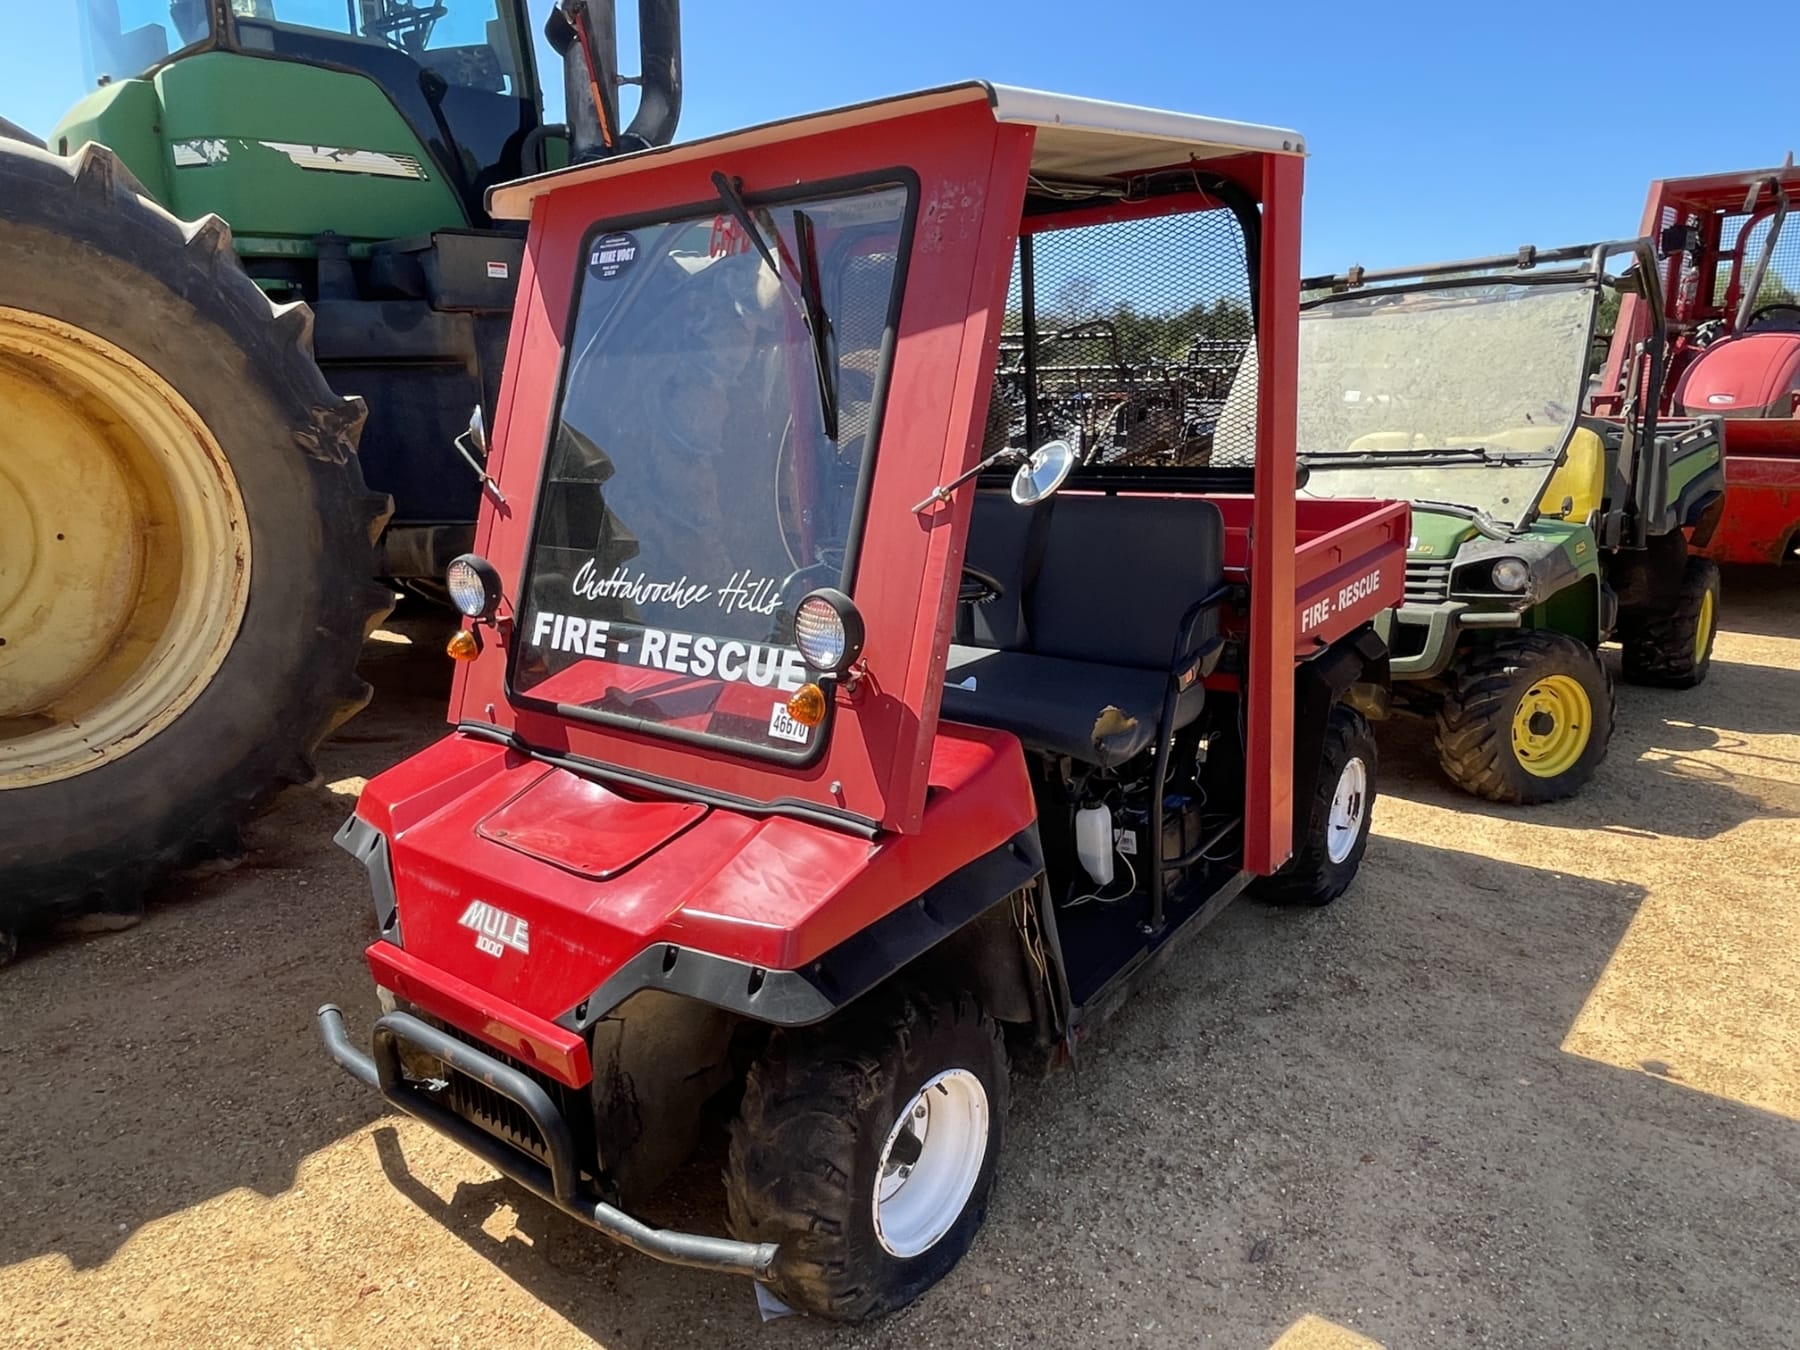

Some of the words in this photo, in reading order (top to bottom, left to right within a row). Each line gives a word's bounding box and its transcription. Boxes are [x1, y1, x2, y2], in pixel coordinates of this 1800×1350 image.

[600, 250, 617, 264] MIKE
[617, 247, 636, 262] VOGT
[572, 557, 712, 609] Chattahoochee
[718, 569, 783, 616] Hills
[1302, 597, 1330, 633] FIRE
[1338, 569, 1380, 612] RESCUE
[531, 611, 611, 659] FIRE
[639, 628, 807, 693] RESCUE
[457, 898, 529, 955] MULE
[475, 935, 505, 958] 1000
